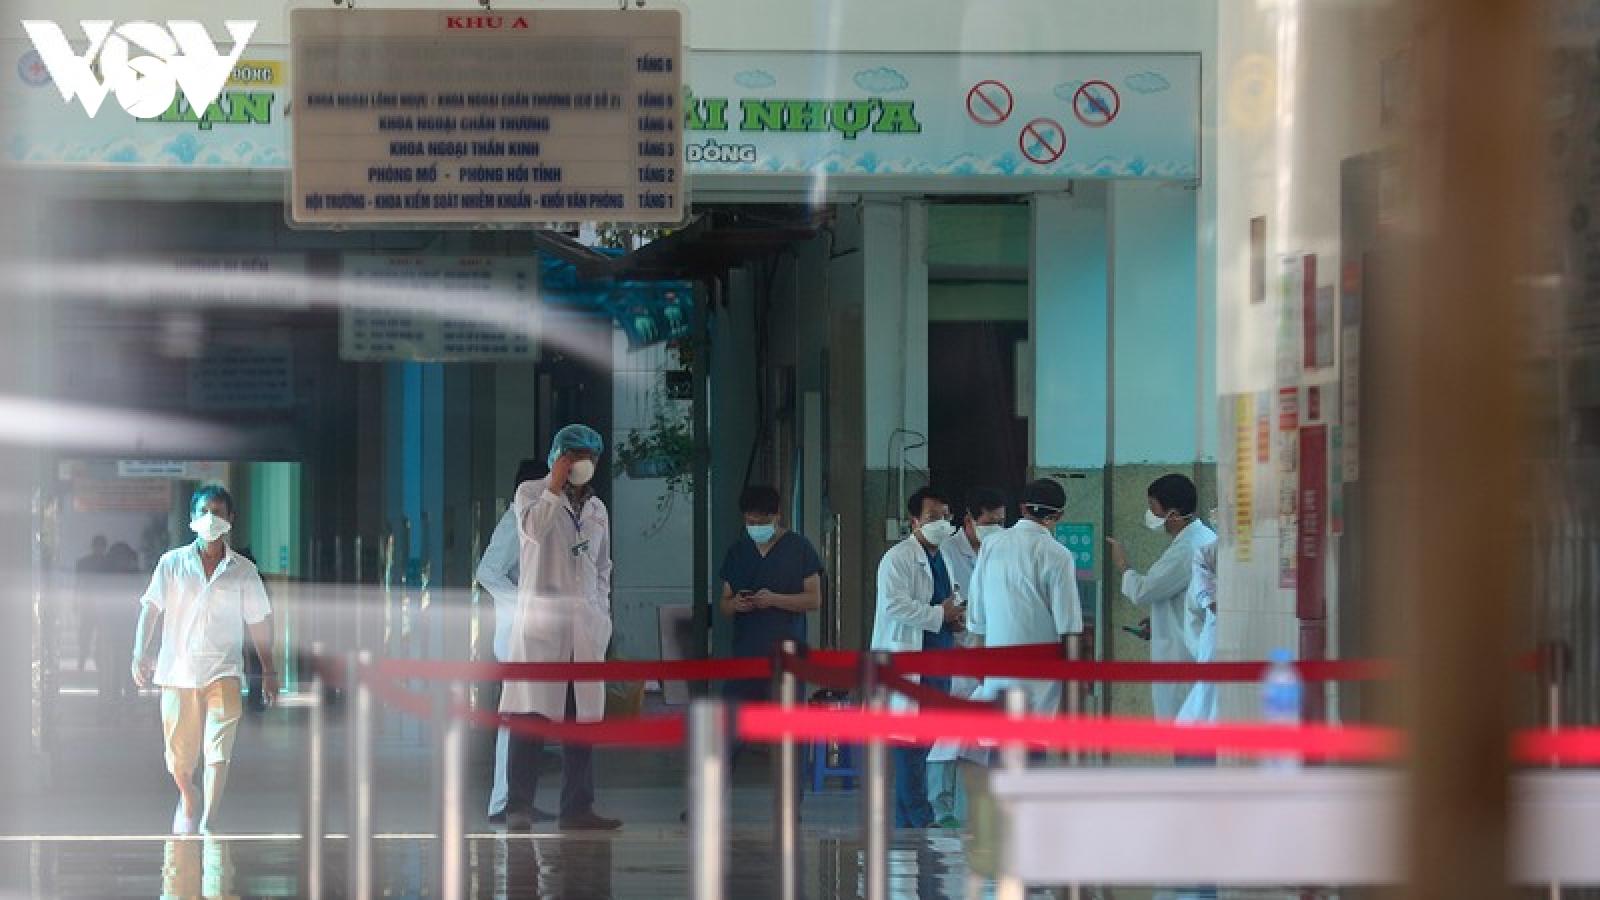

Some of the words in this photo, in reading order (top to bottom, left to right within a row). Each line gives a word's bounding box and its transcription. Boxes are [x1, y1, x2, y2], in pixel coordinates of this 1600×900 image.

[446, 16, 503, 29] KHU
[511, 16, 529, 29] A
[379, 116, 413, 131] KHOA
[740, 97, 922, 140] NHỰA
[389, 141, 425, 156] KHOA
[427, 141, 468, 158] NGOẠI
[507, 141, 540, 156] KINH
[367, 164, 413, 182] PHÒNG
[459, 164, 503, 182] PHÒNG
[638, 162, 665, 182] TẦNG
[667, 167, 674, 182] 2
[374, 193, 402, 208] KHOA
[589, 190, 624, 208] PHÒNG
[638, 190, 665, 208] TẦNG
[667, 193, 673, 208] 1
